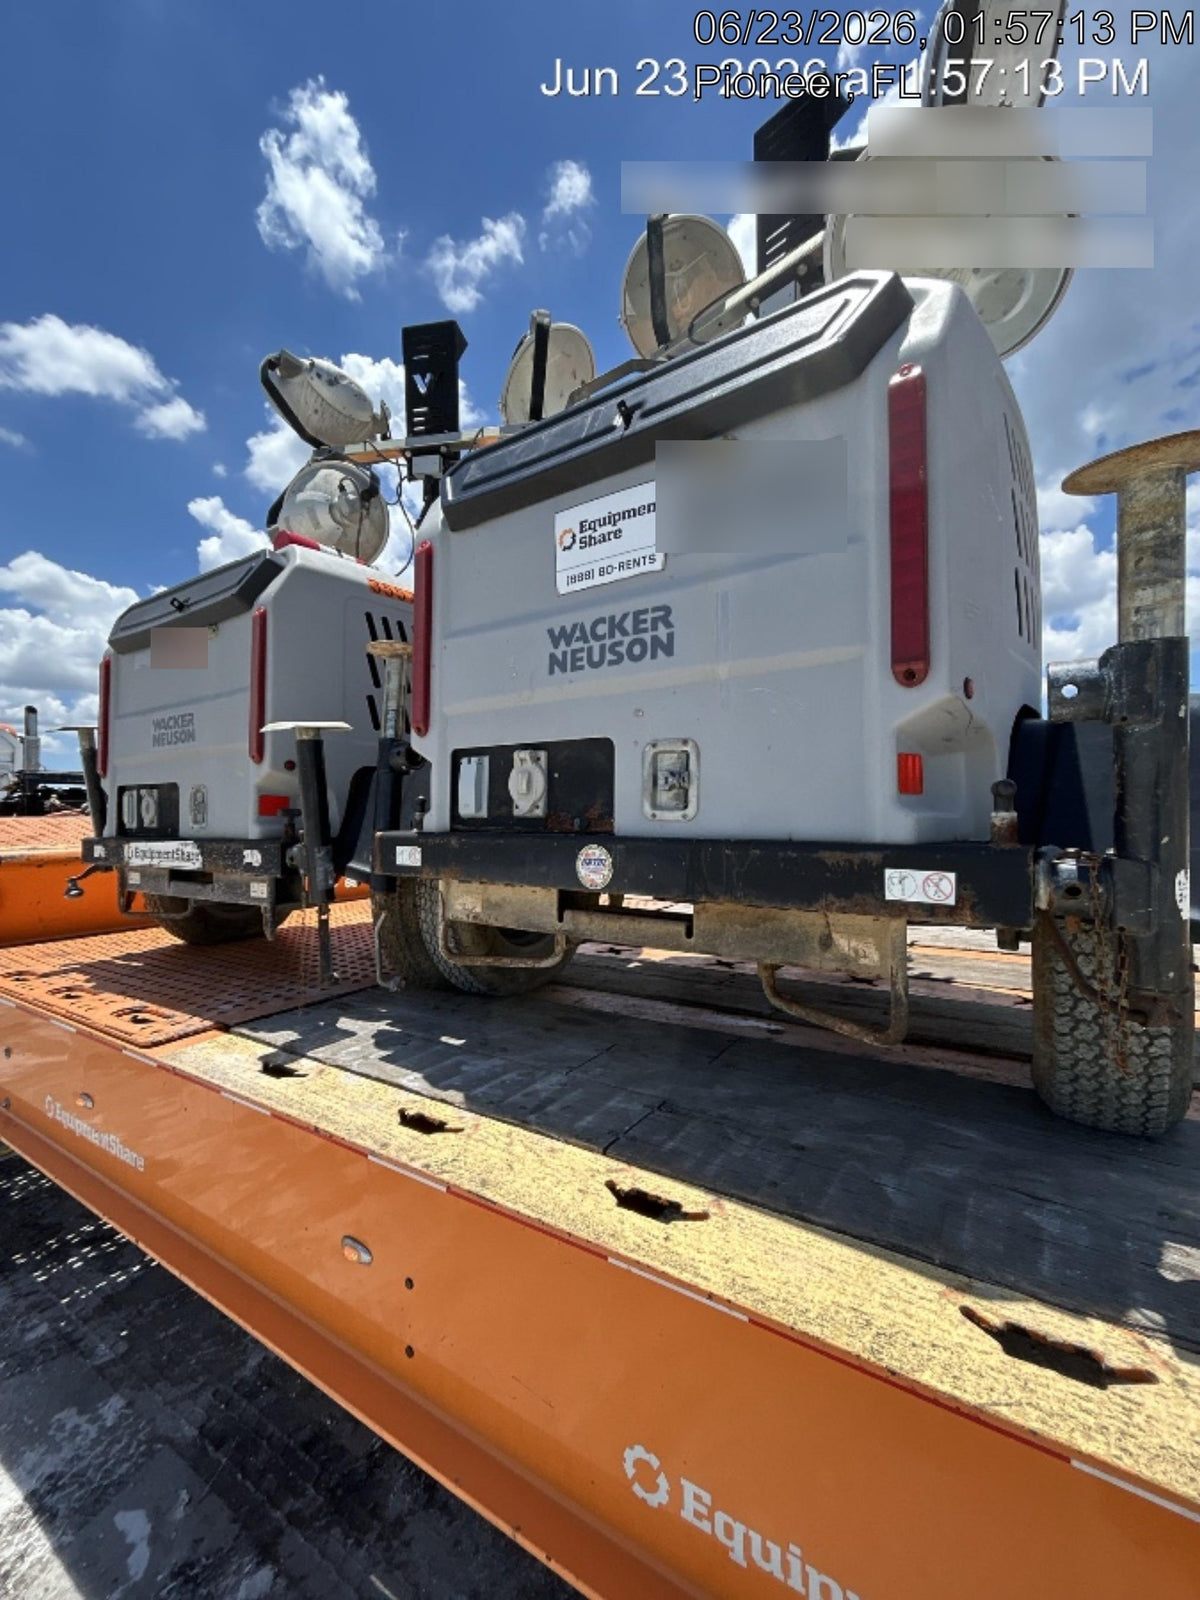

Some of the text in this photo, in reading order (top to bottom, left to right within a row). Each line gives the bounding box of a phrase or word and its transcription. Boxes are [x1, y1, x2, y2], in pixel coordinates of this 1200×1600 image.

[578, 528, 623, 550] Share
[598, 553, 657, 577] 80-RENTS
[547, 604, 675, 650] WACKER
[548, 631, 675, 676] NEUSON
[152, 712, 195, 733] WACKER
[152, 729, 196, 748] NEUSON
[55, 1102, 144, 1172] EquipmentShare
[680, 1477, 860, 1600] Equip
